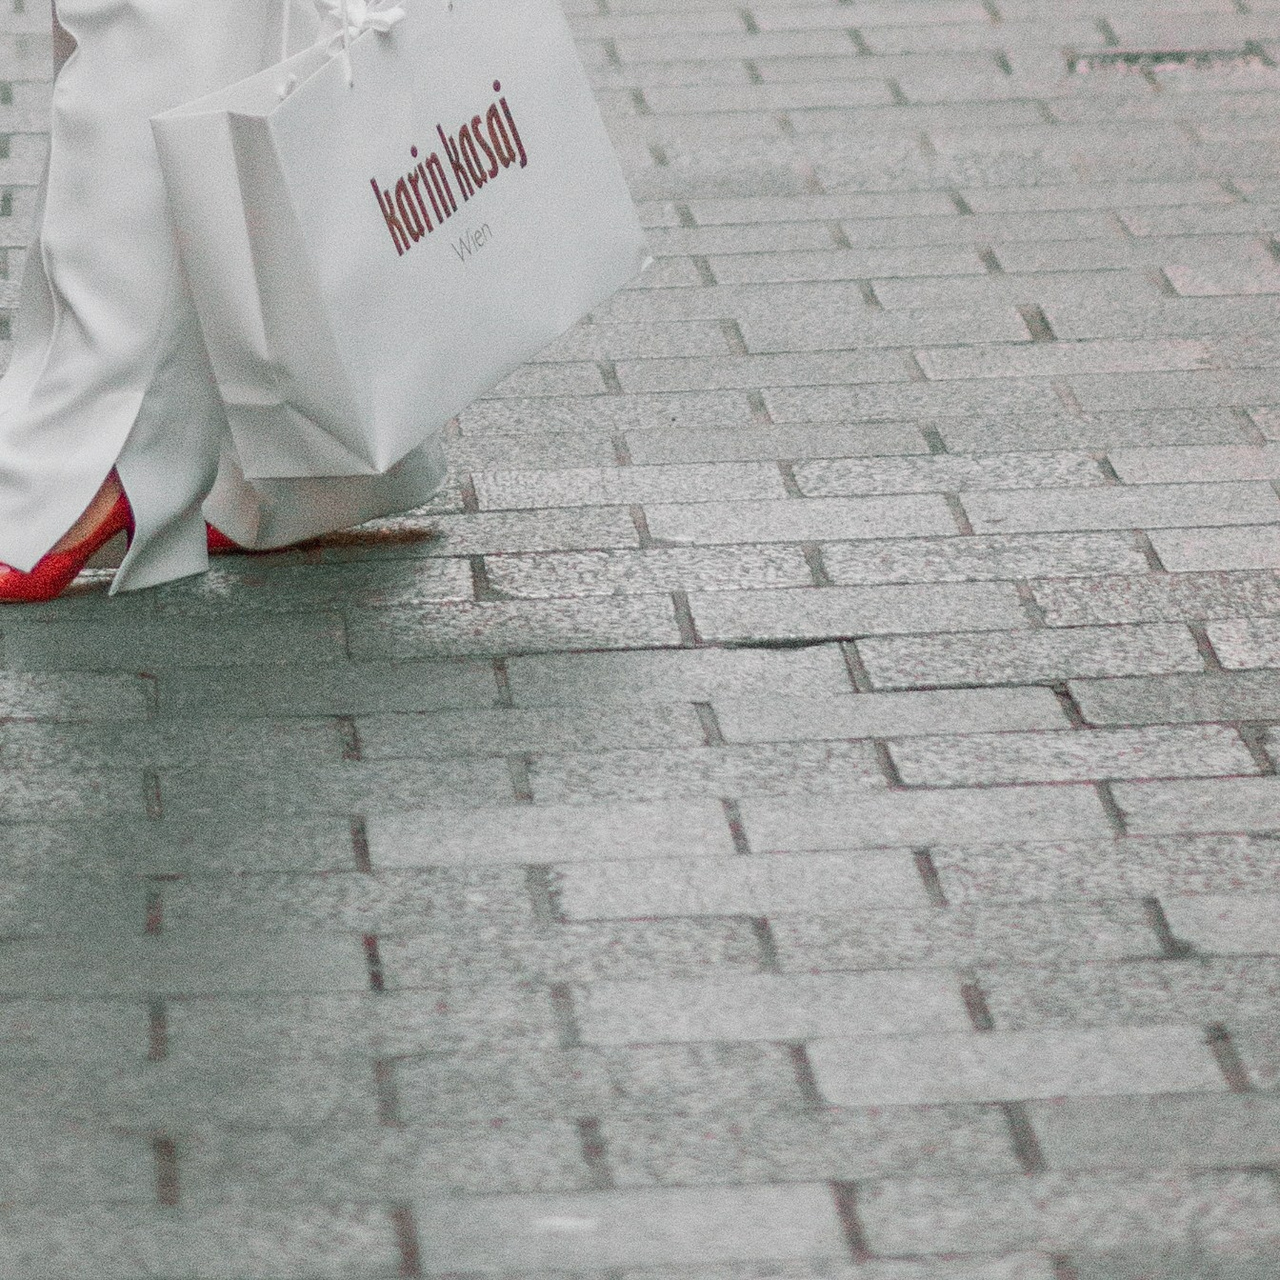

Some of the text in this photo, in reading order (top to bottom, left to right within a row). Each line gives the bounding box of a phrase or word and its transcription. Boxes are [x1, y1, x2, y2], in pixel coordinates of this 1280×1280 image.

[370, 79, 528, 256] karin kasaj
[450, 223, 493, 262] Wien
